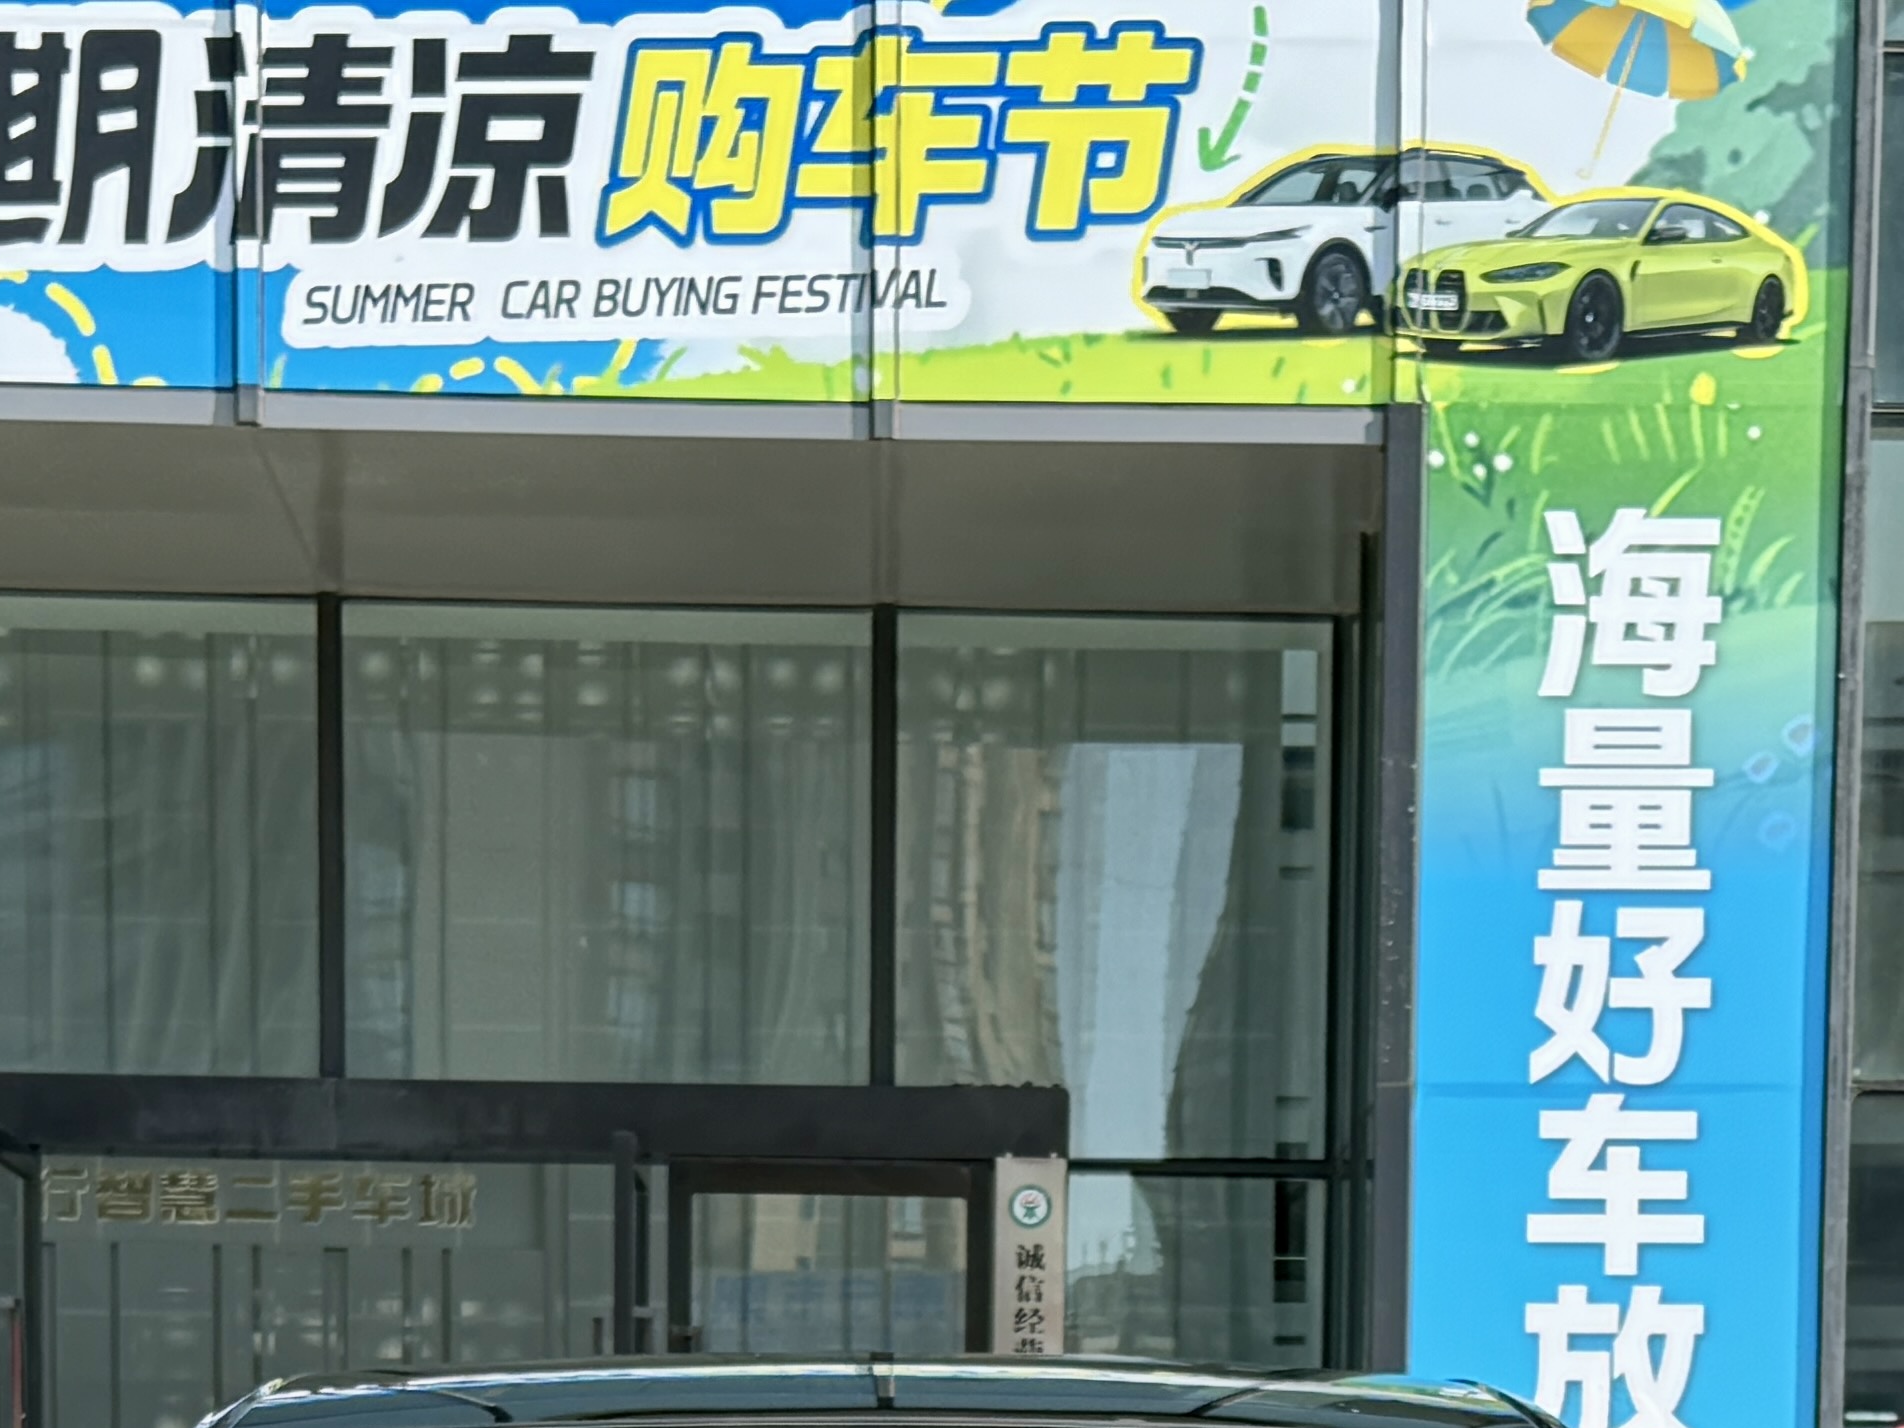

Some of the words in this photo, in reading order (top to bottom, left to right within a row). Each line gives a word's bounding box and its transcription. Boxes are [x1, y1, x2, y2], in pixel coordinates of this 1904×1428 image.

[302, 282, 475, 325] SUMMER
[500, 279, 581, 320] CAR
[593, 275, 745, 318] BUYING
[751, 268, 948, 316] FESTIVAL
